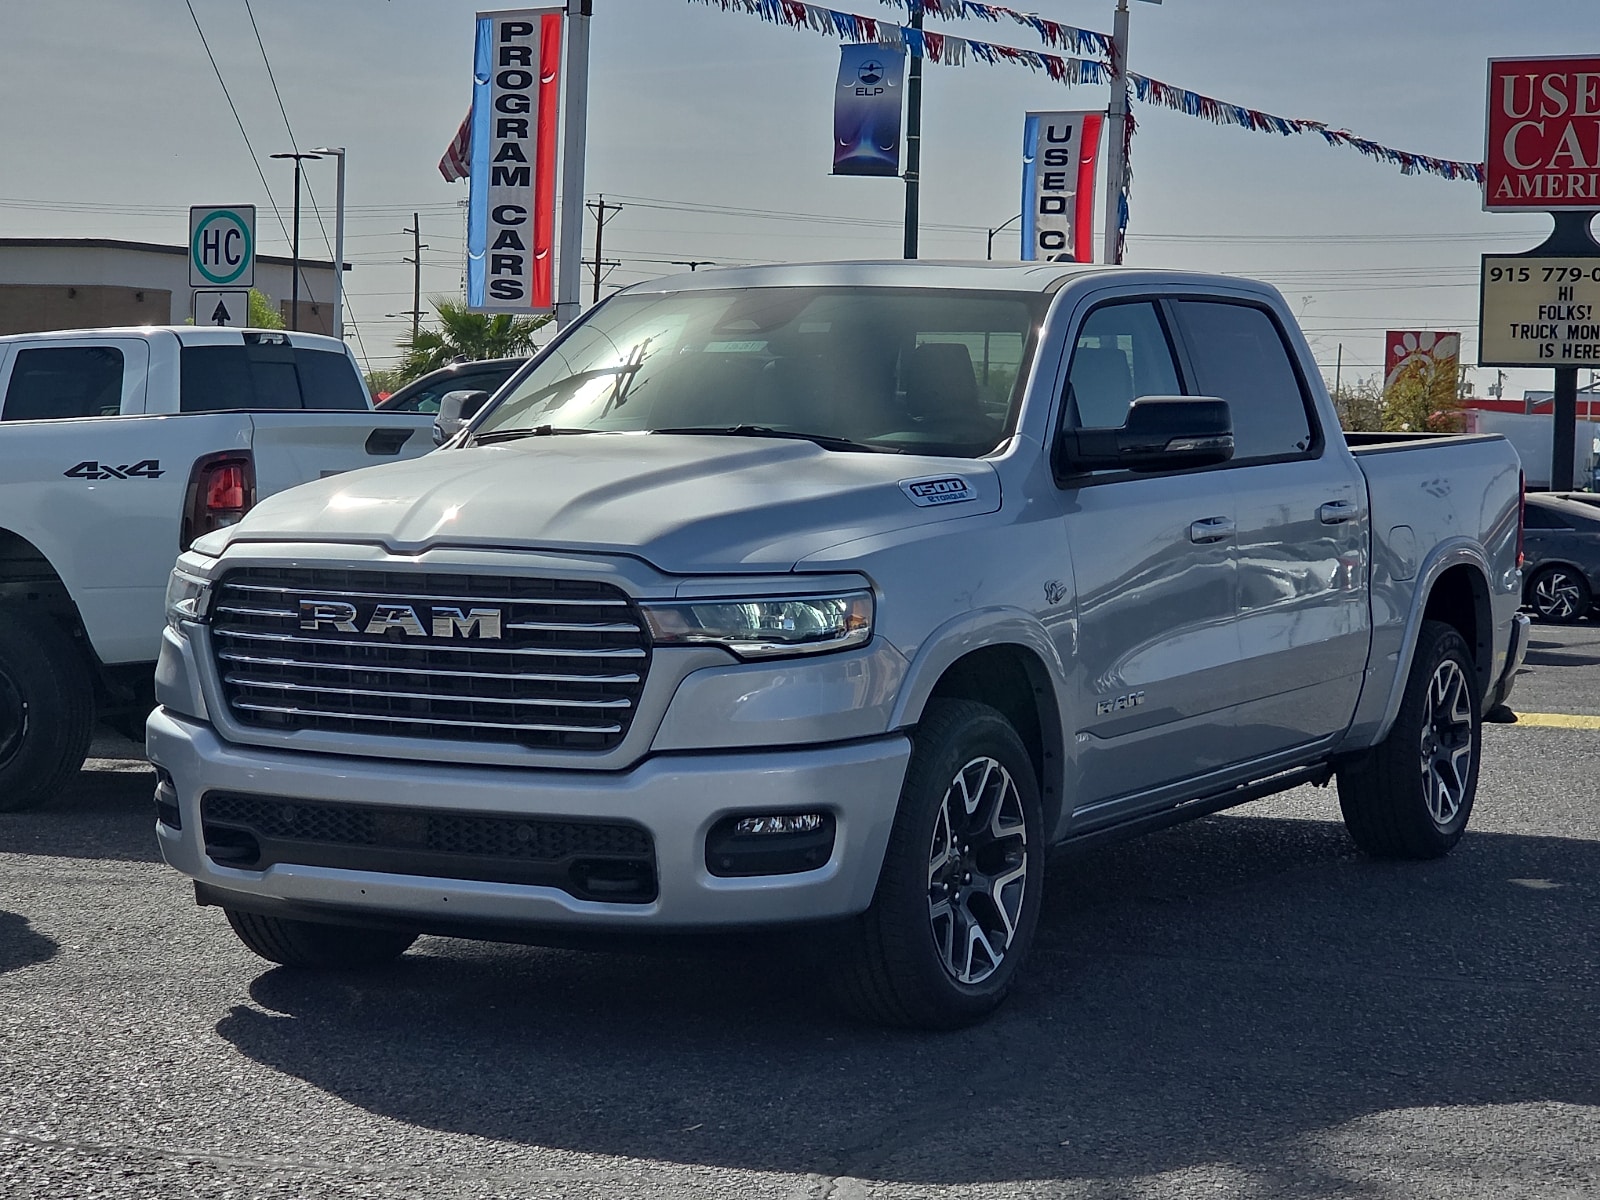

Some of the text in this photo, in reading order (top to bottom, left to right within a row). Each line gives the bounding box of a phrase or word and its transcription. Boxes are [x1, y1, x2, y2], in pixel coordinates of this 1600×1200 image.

[855, 87, 884, 97] ELP
[1500, 73, 1600, 119] USE
[489, 21, 534, 300] PROGRAM CARS
[1039, 125, 1073, 262] USED C
[1493, 173, 1599, 199] AMERI
[203, 228, 241, 266] HC
[1490, 267, 1530, 282] 915
[1558, 286, 1574, 301] HI
[1538, 304, 1592, 321] FOLKS!
[1509, 323, 1600, 340] TRUCK MON
[1539, 343, 1600, 359] IS HERE
[63, 459, 166, 480] 4x4
[911, 480, 964, 496] 1500
[299, 599, 502, 640] RAM
[1095, 690, 1145, 716] RAM
